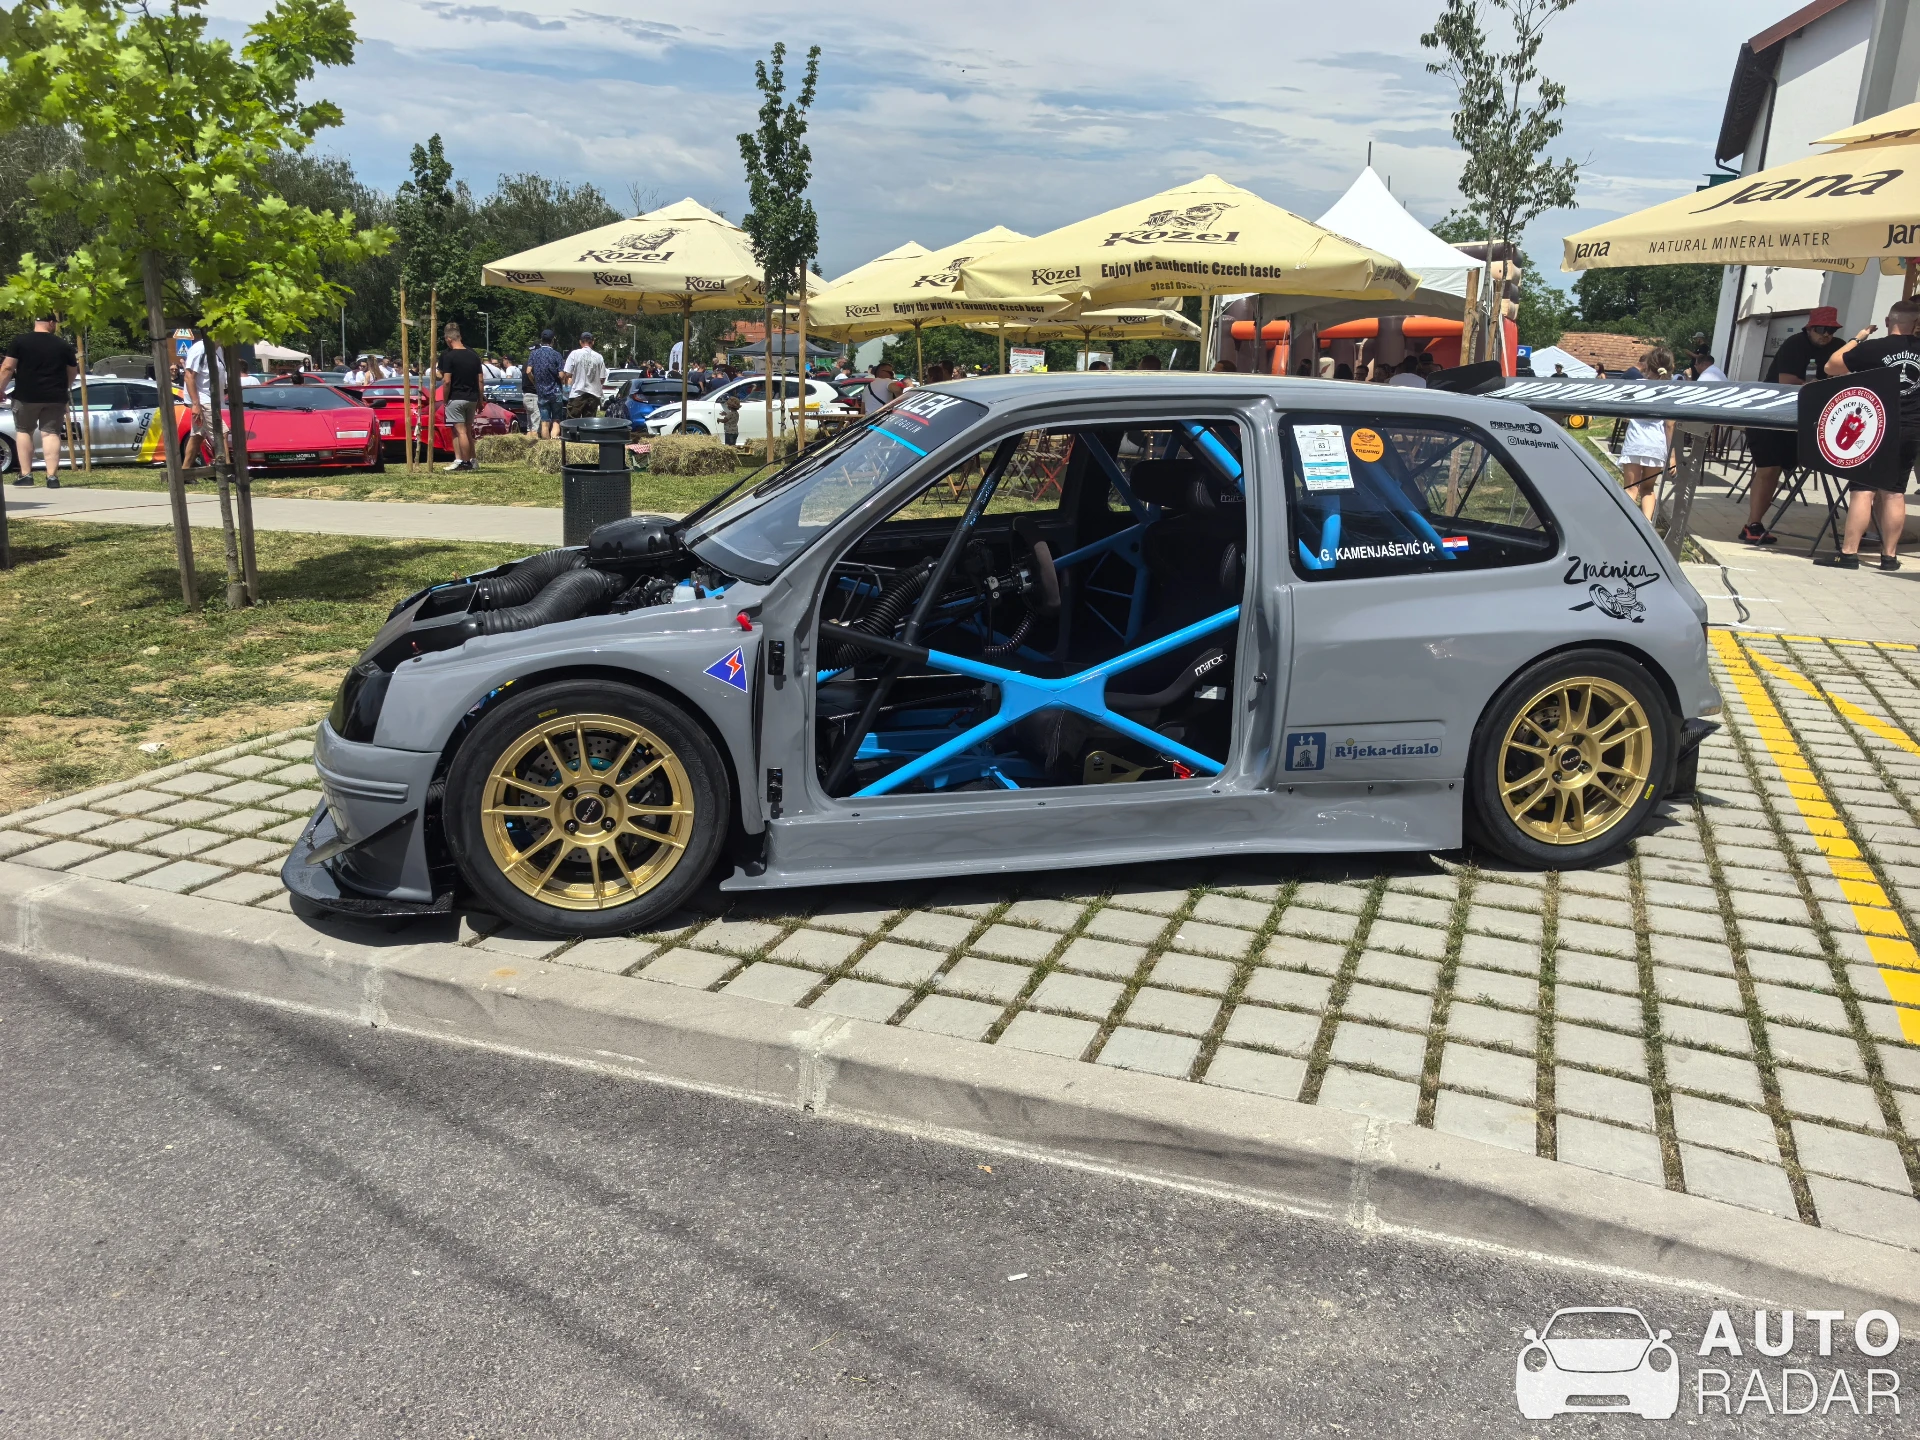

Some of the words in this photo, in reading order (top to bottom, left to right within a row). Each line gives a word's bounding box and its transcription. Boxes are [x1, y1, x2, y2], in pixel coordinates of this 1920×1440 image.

[1098, 229, 1240, 247] Kozel
[574, 249, 675, 264] Kozel
[1573, 239, 1611, 264] Jana
[1648, 238, 1707, 253] NATURAL
[1712, 234, 1774, 250] MINERAL
[1779, 232, 1830, 247] WATER
[505, 271, 546, 284] Kozel
[592, 271, 634, 287] Kozel
[1031, 265, 1081, 286] Kozel
[1101, 261, 1131, 279] Enjoy
[1134, 259, 1153, 273] the
[1155, 260, 1209, 275] authentic
[1211, 261, 1248, 276] Czech
[1250, 263, 1282, 278] taste
[684, 275, 728, 292] Kozel
[845, 303, 881, 318] Kozel
[893, 302, 914, 315] Enjoy
[916, 302, 929, 312] the
[961, 302, 998, 312] favourite
[999, 303, 1025, 312] Czech
[1026, 304, 1045, 313] beer
[131, 412, 152, 452] CELICA
[1320, 548, 1333, 562] G.
[1335, 540, 1421, 561] KAMENJAŠEVIĆ
[1563, 556, 1660, 586] Zračnica
[1335, 739, 1439, 760] Rijeka-dizalo
